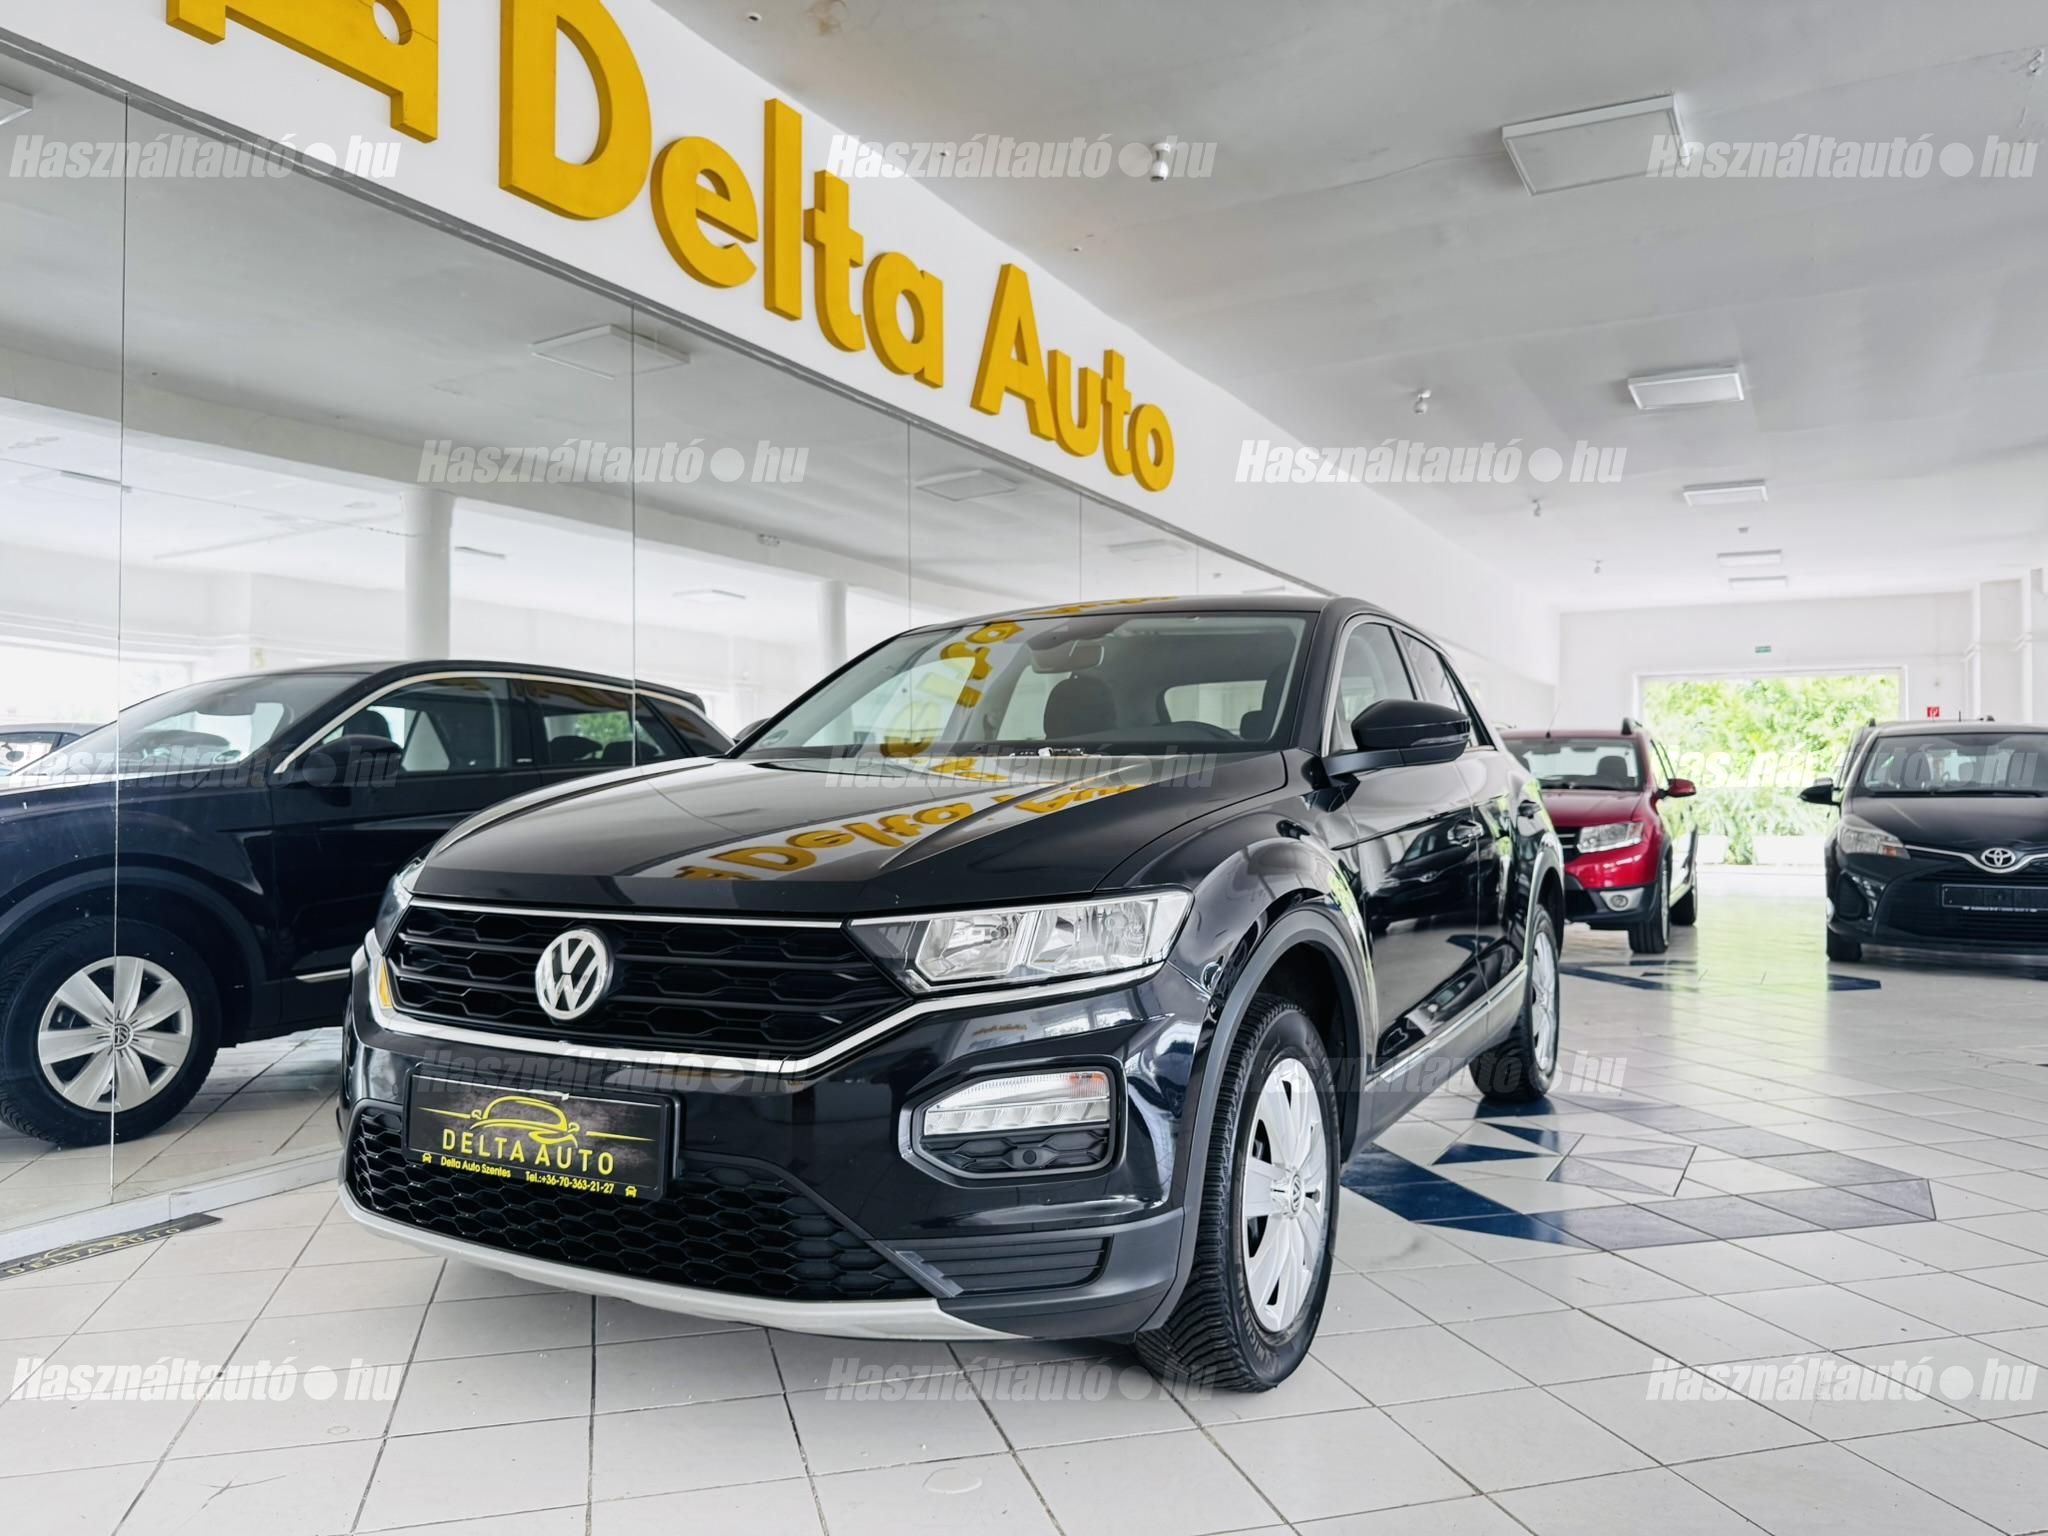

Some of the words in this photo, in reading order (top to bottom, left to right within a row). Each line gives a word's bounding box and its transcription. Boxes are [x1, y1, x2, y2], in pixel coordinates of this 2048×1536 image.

[499, 0, 943, 389] Delta
[969, 263, 1174, 492] Auto
[441, 1158, 461, 1169] Delta
[462, 1162, 481, 1172] Auto
[482, 1164, 511, 1178] Szentes
[443, 1129, 525, 1163] DELTA
[534, 1144, 615, 1176] AUTO
